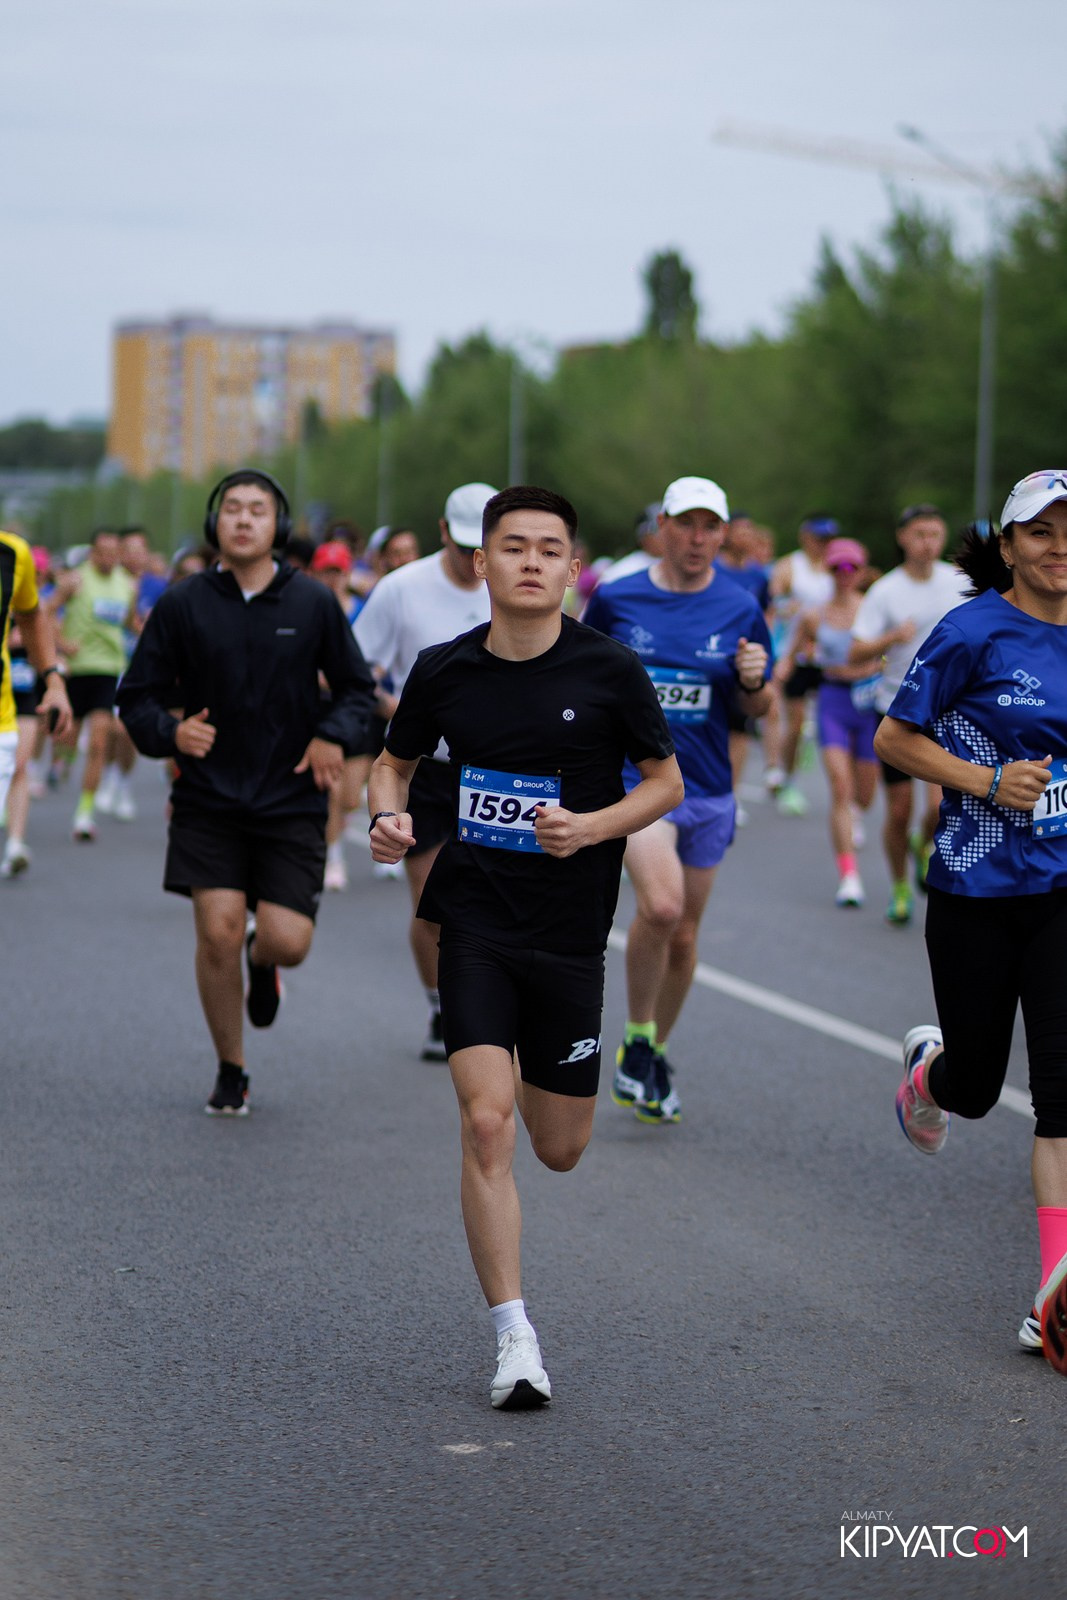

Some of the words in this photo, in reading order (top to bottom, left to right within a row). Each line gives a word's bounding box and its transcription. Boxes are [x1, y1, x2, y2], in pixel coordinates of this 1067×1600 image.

[1013, 697, 1046, 707] GROUP
[464, 769, 471, 779] 5
[472, 773, 485, 782] KM
[522, 781, 544, 789] GROUP
[468, 792, 547, 827] 1594
